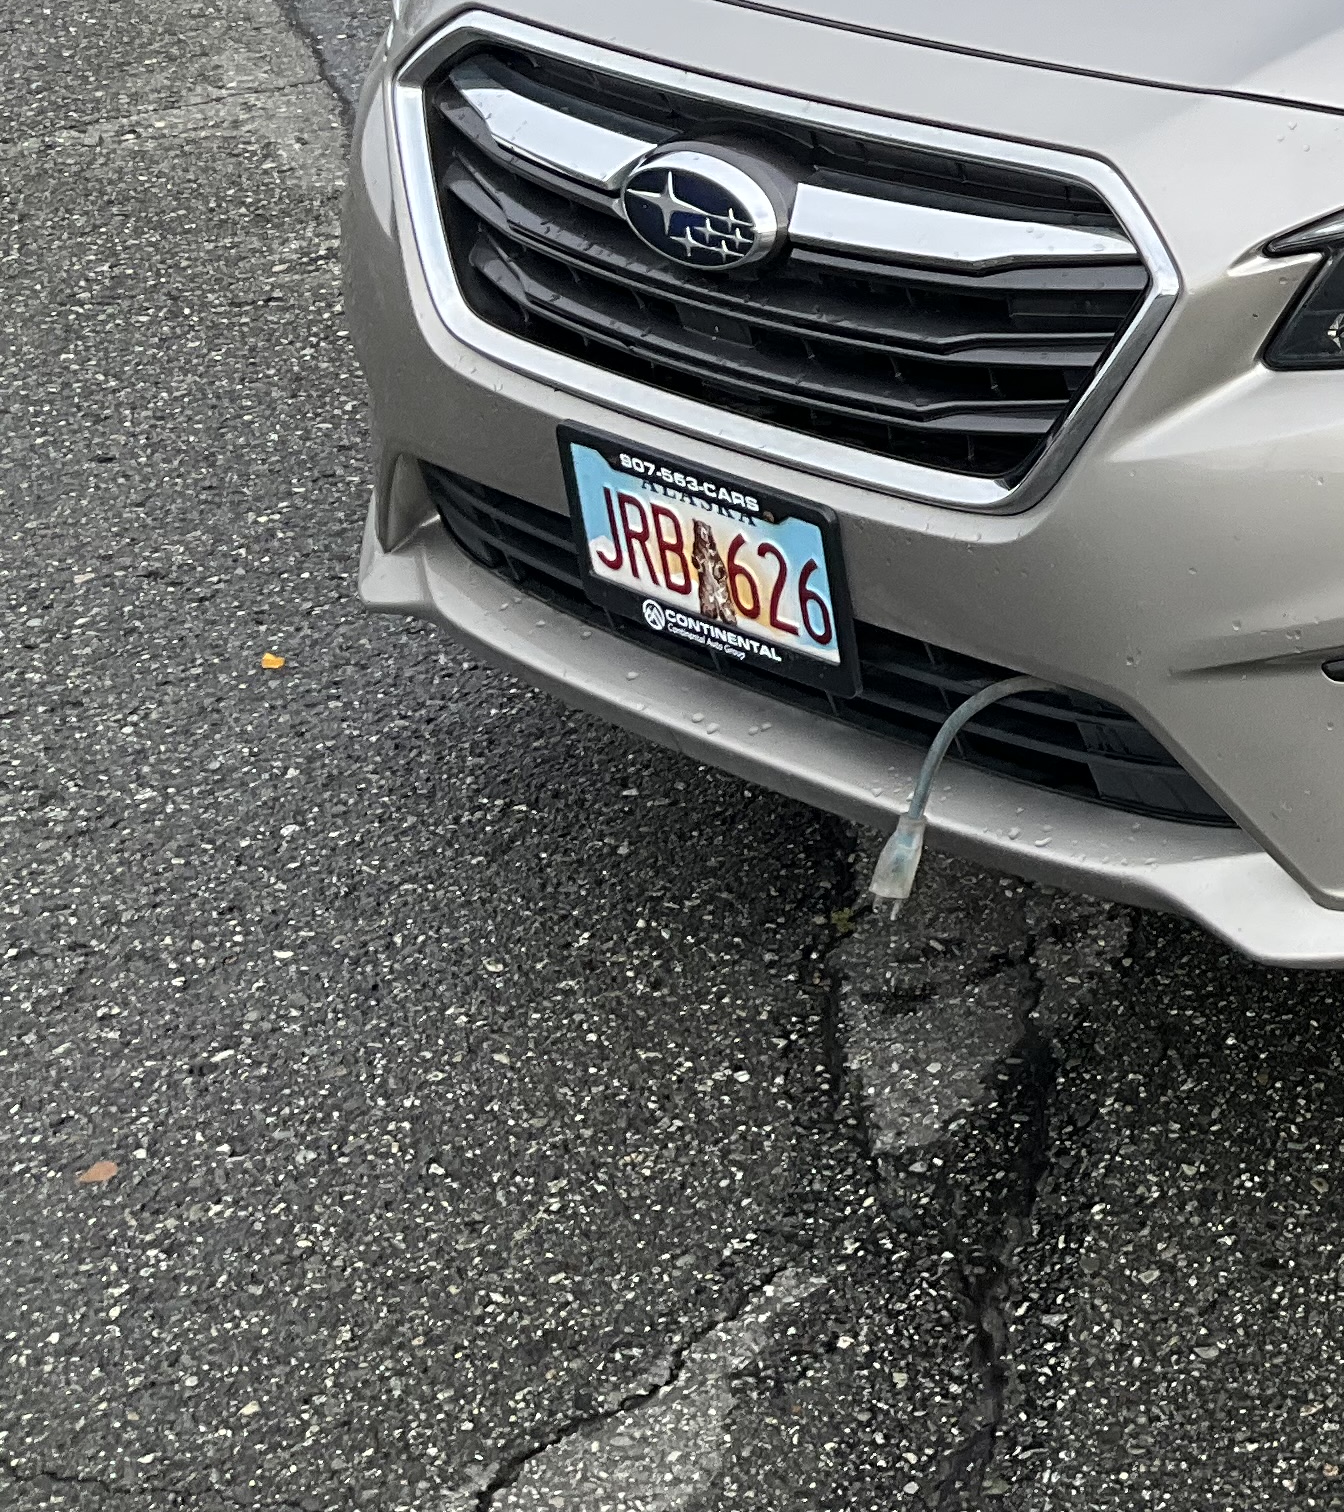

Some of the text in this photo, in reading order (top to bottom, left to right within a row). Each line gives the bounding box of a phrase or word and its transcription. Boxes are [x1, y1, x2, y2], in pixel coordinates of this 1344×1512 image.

[619, 453, 760, 512] 907-563-CARS
[596, 486, 832, 645] JRB 626
[665, 609, 782, 662] CONTINENTAL
